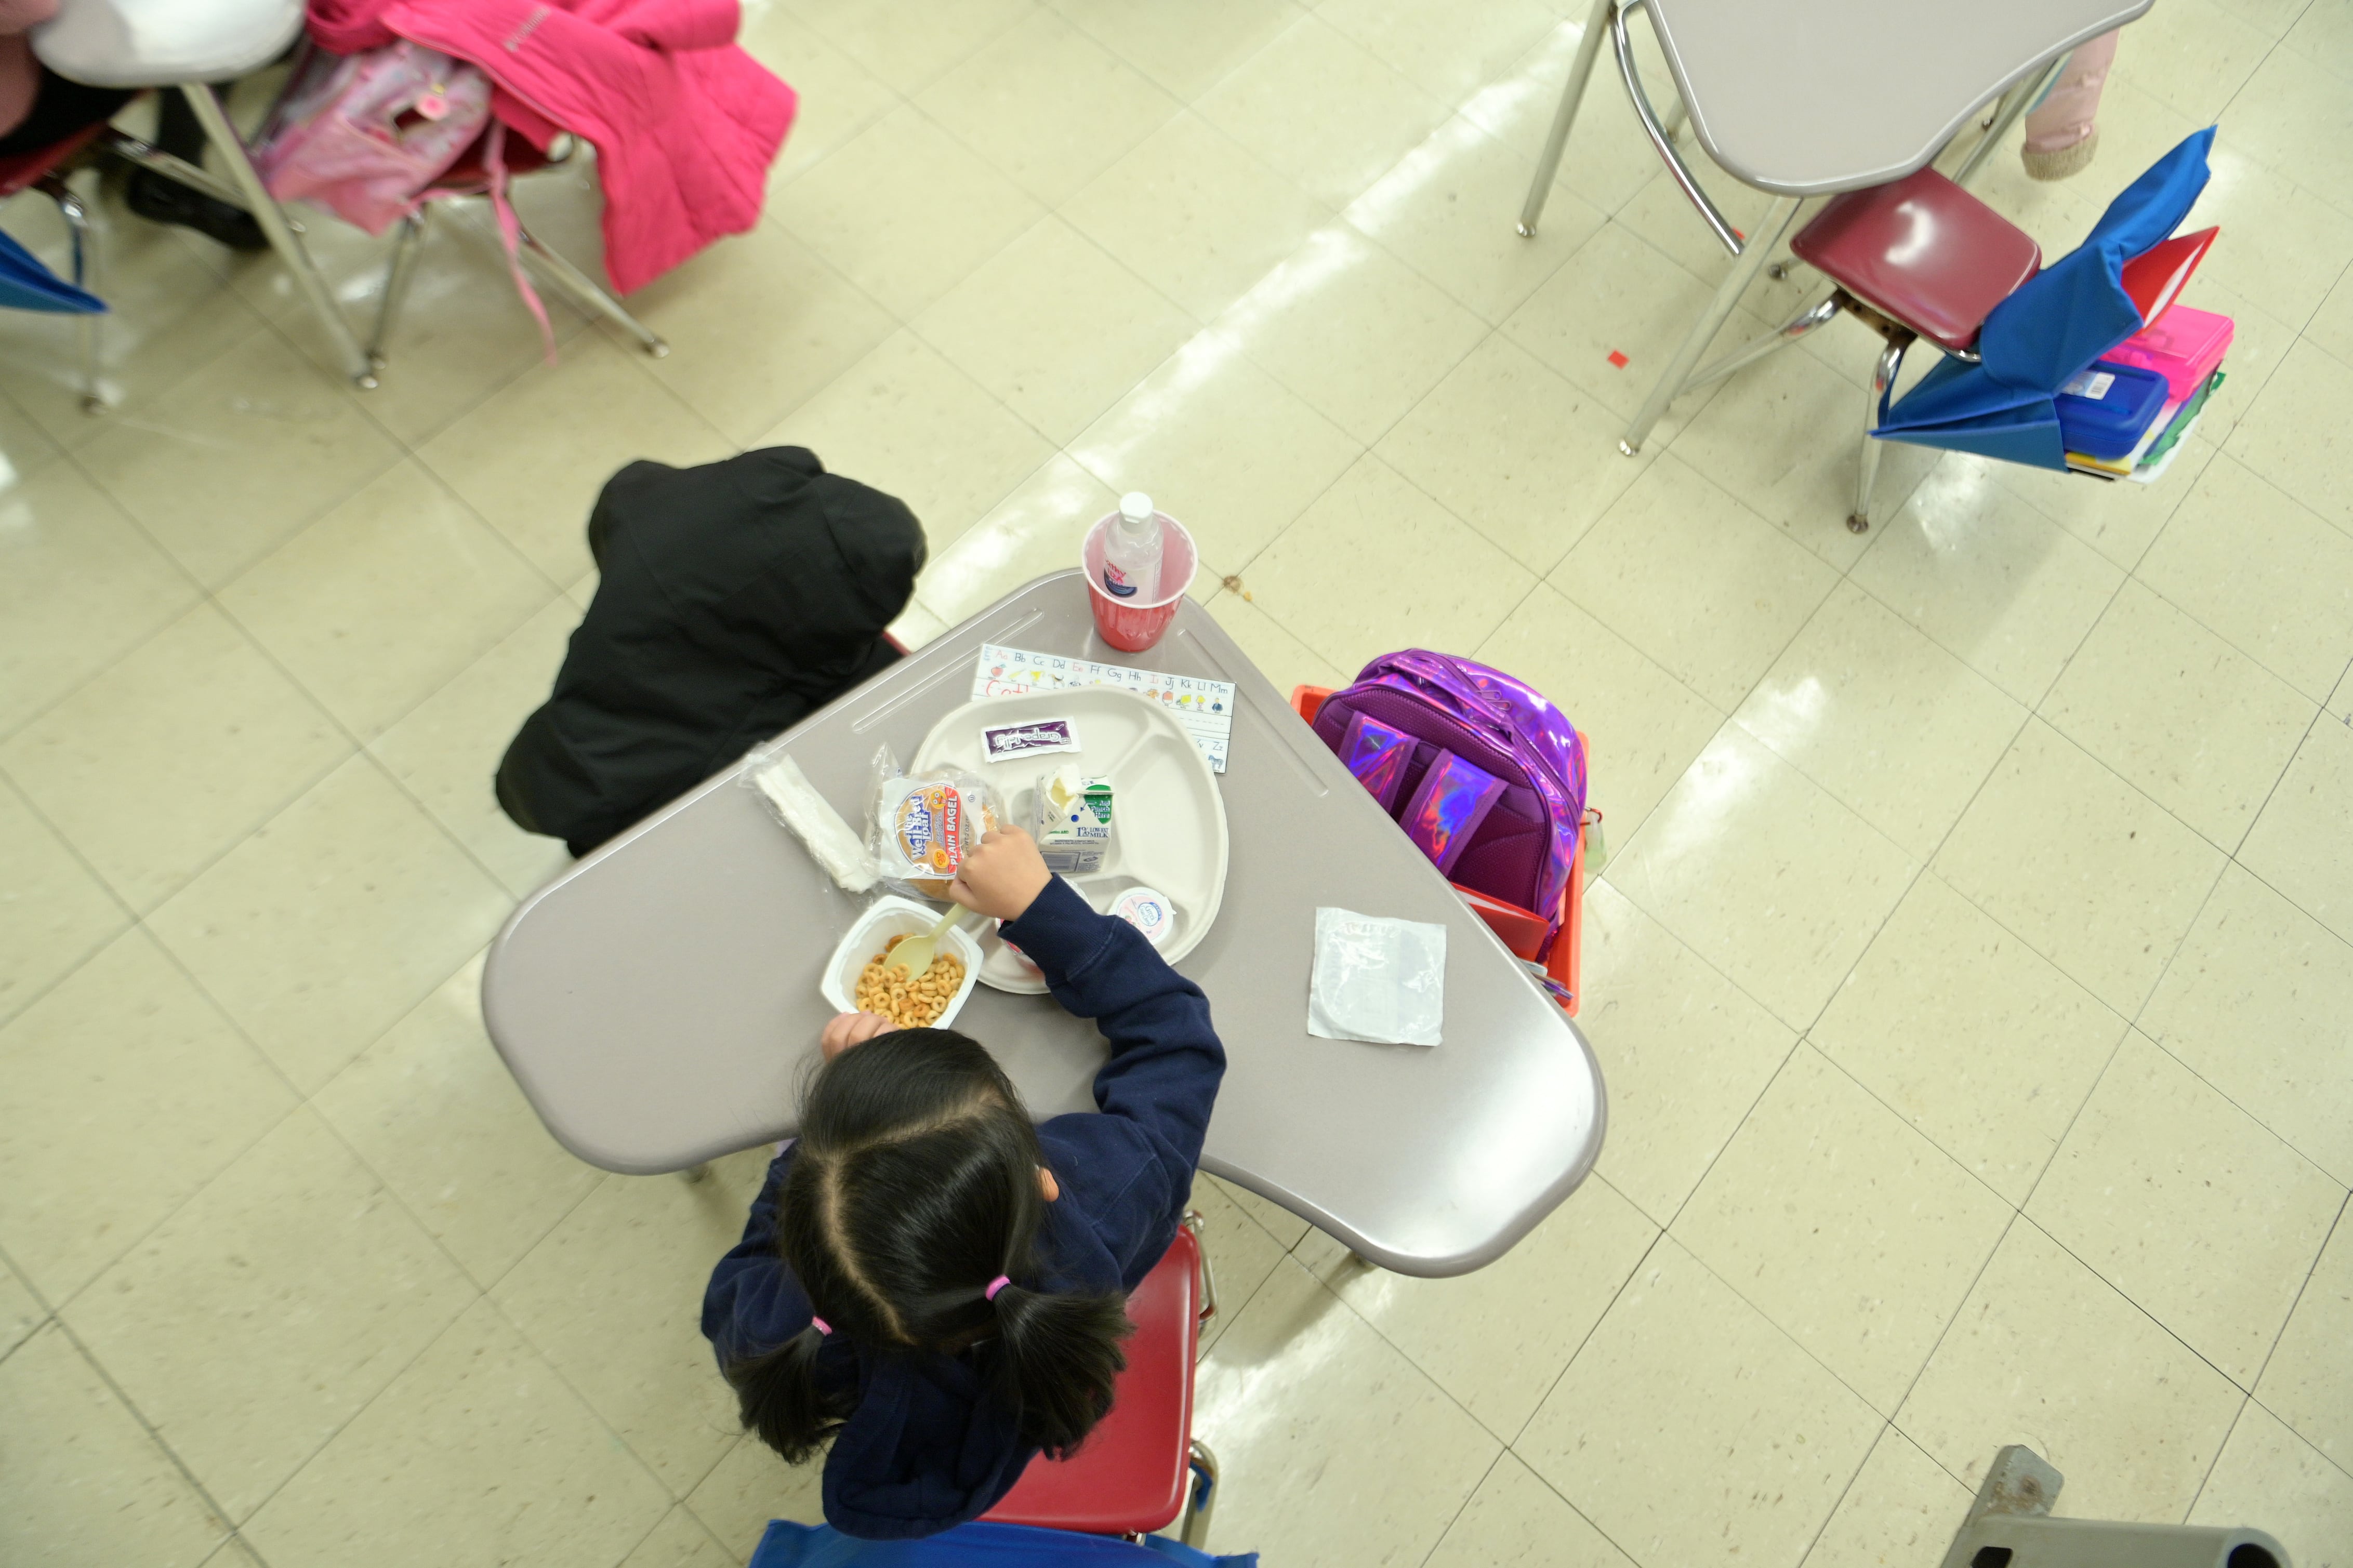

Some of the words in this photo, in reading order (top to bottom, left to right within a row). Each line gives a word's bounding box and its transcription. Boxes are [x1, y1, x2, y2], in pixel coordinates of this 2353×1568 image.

[996, 650, 1008, 660] Aa
[1015, 653, 1026, 662] Bb
[1033, 656, 1045, 666] Cc
[1053, 659, 1065, 669] Dd
[1072, 662, 1083, 672] Ee
[1090, 665, 1101, 674] Ff
[1107, 668, 1122, 682] Gg
[1129, 671, 1141, 682] Hh
[1150, 674, 1159, 684] Ii
[1165, 677, 1174, 690] Jj
[1181, 679, 1192, 689] Kk
[1197, 682, 1206, 691] Ll
[1210, 683, 1228, 694] Mm
[1024, 728, 1061, 741] Grape
[1213, 741, 1223, 751] Zz
[922, 812, 932, 840] Loaf
[946, 795, 958, 831] BAGEL
[1077, 827, 1090, 837] 1%
[948, 836, 958, 866] PLAIN
